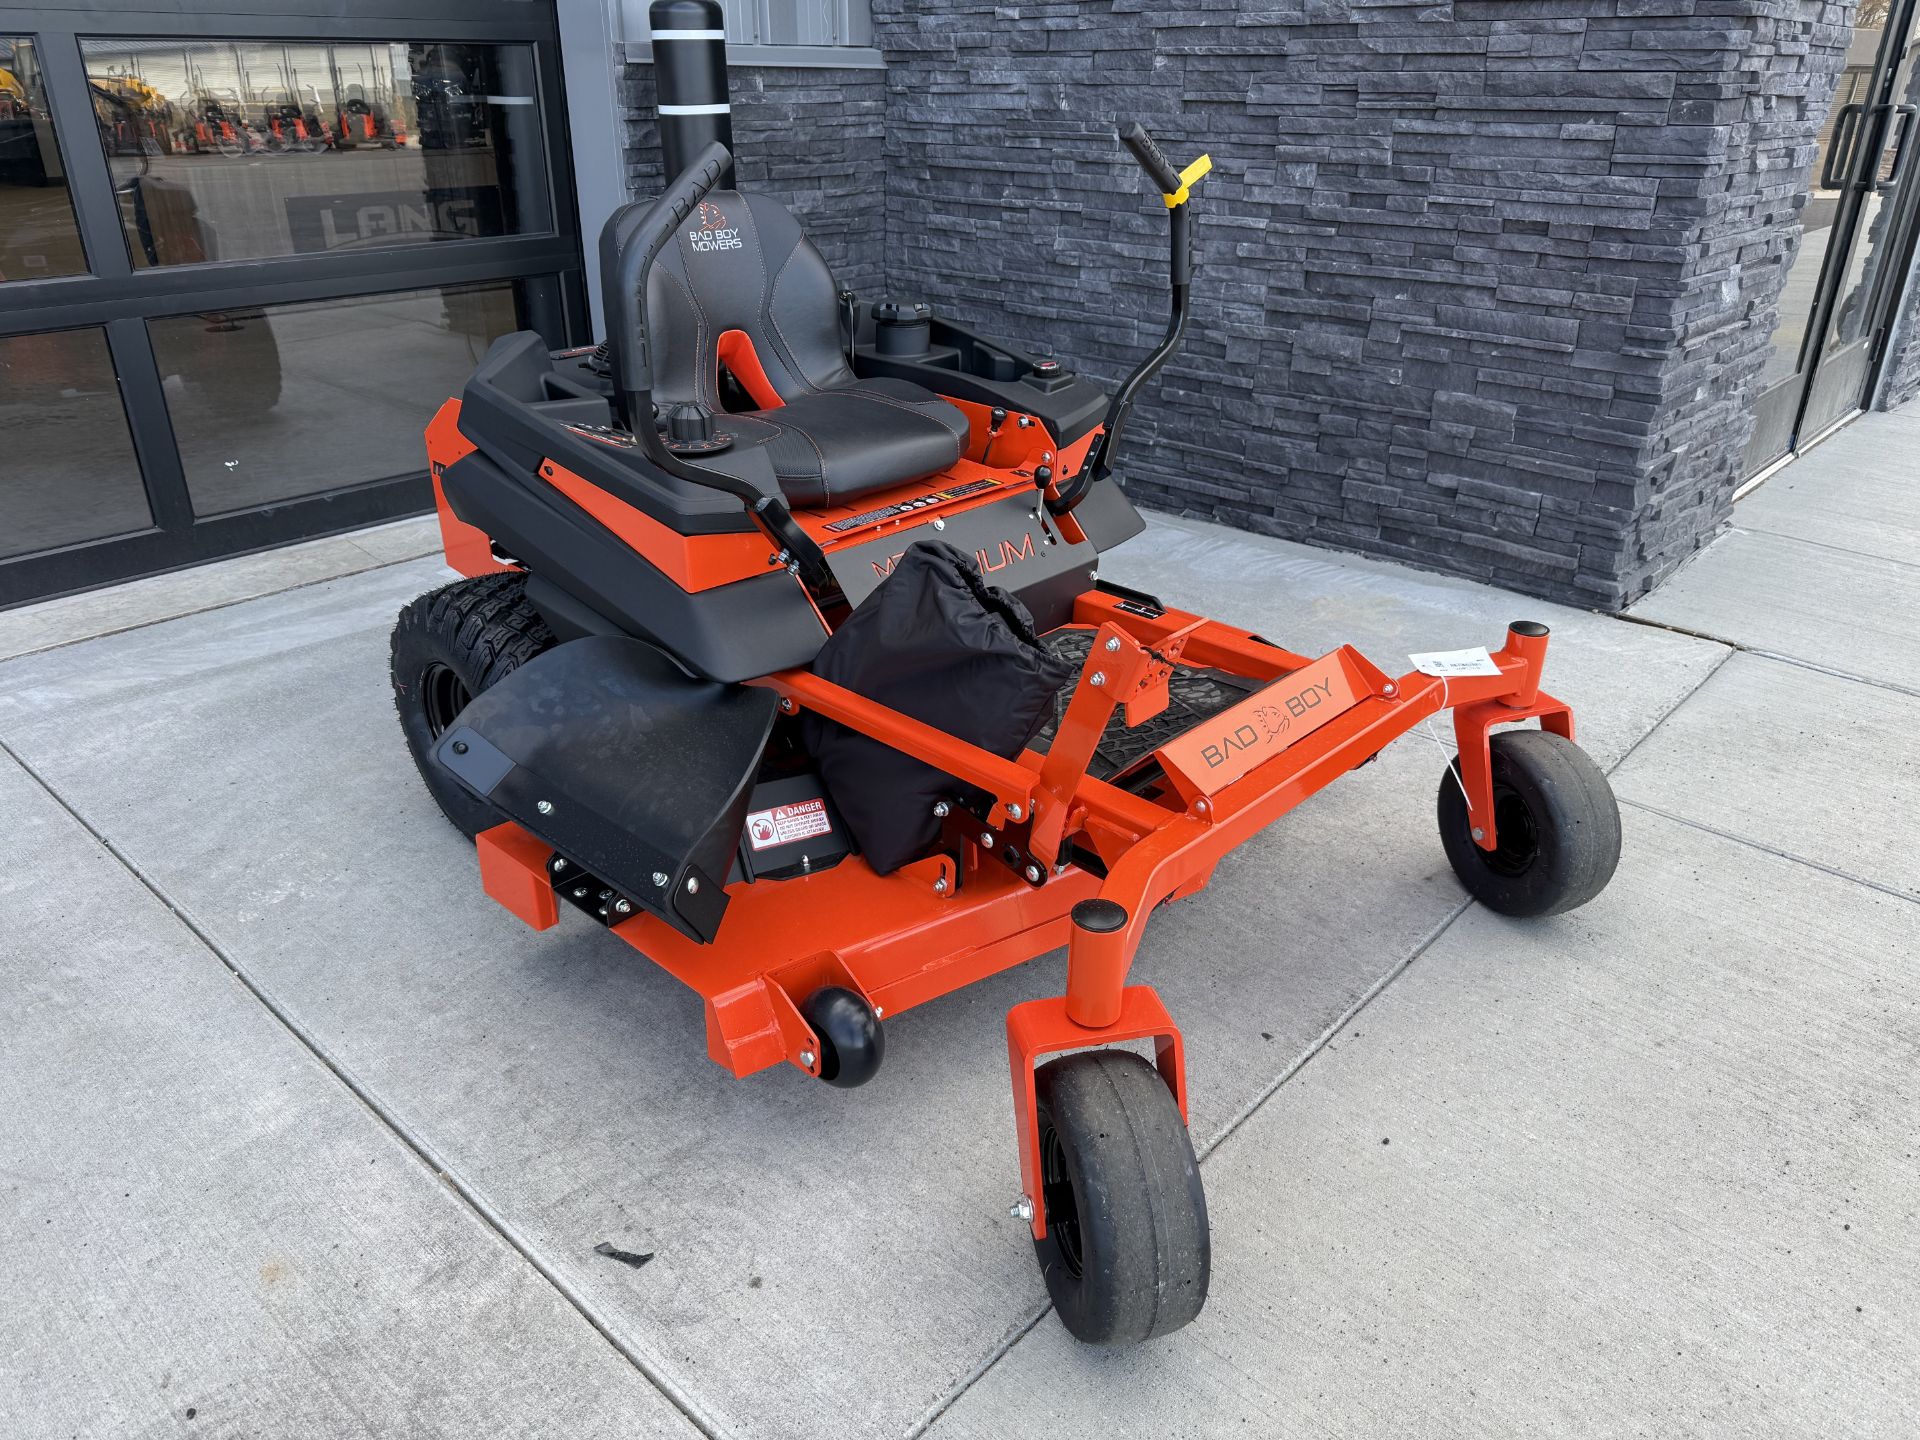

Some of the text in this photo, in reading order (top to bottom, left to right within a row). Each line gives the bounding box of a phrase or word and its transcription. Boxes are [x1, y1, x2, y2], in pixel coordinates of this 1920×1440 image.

[319, 199, 480, 249] LANG
[689, 227, 739, 241] BAD BOY
[691, 238, 743, 252] MOWERS
[1200, 676, 1332, 769] BAD BOY
[787, 801, 822, 816] DANGER
